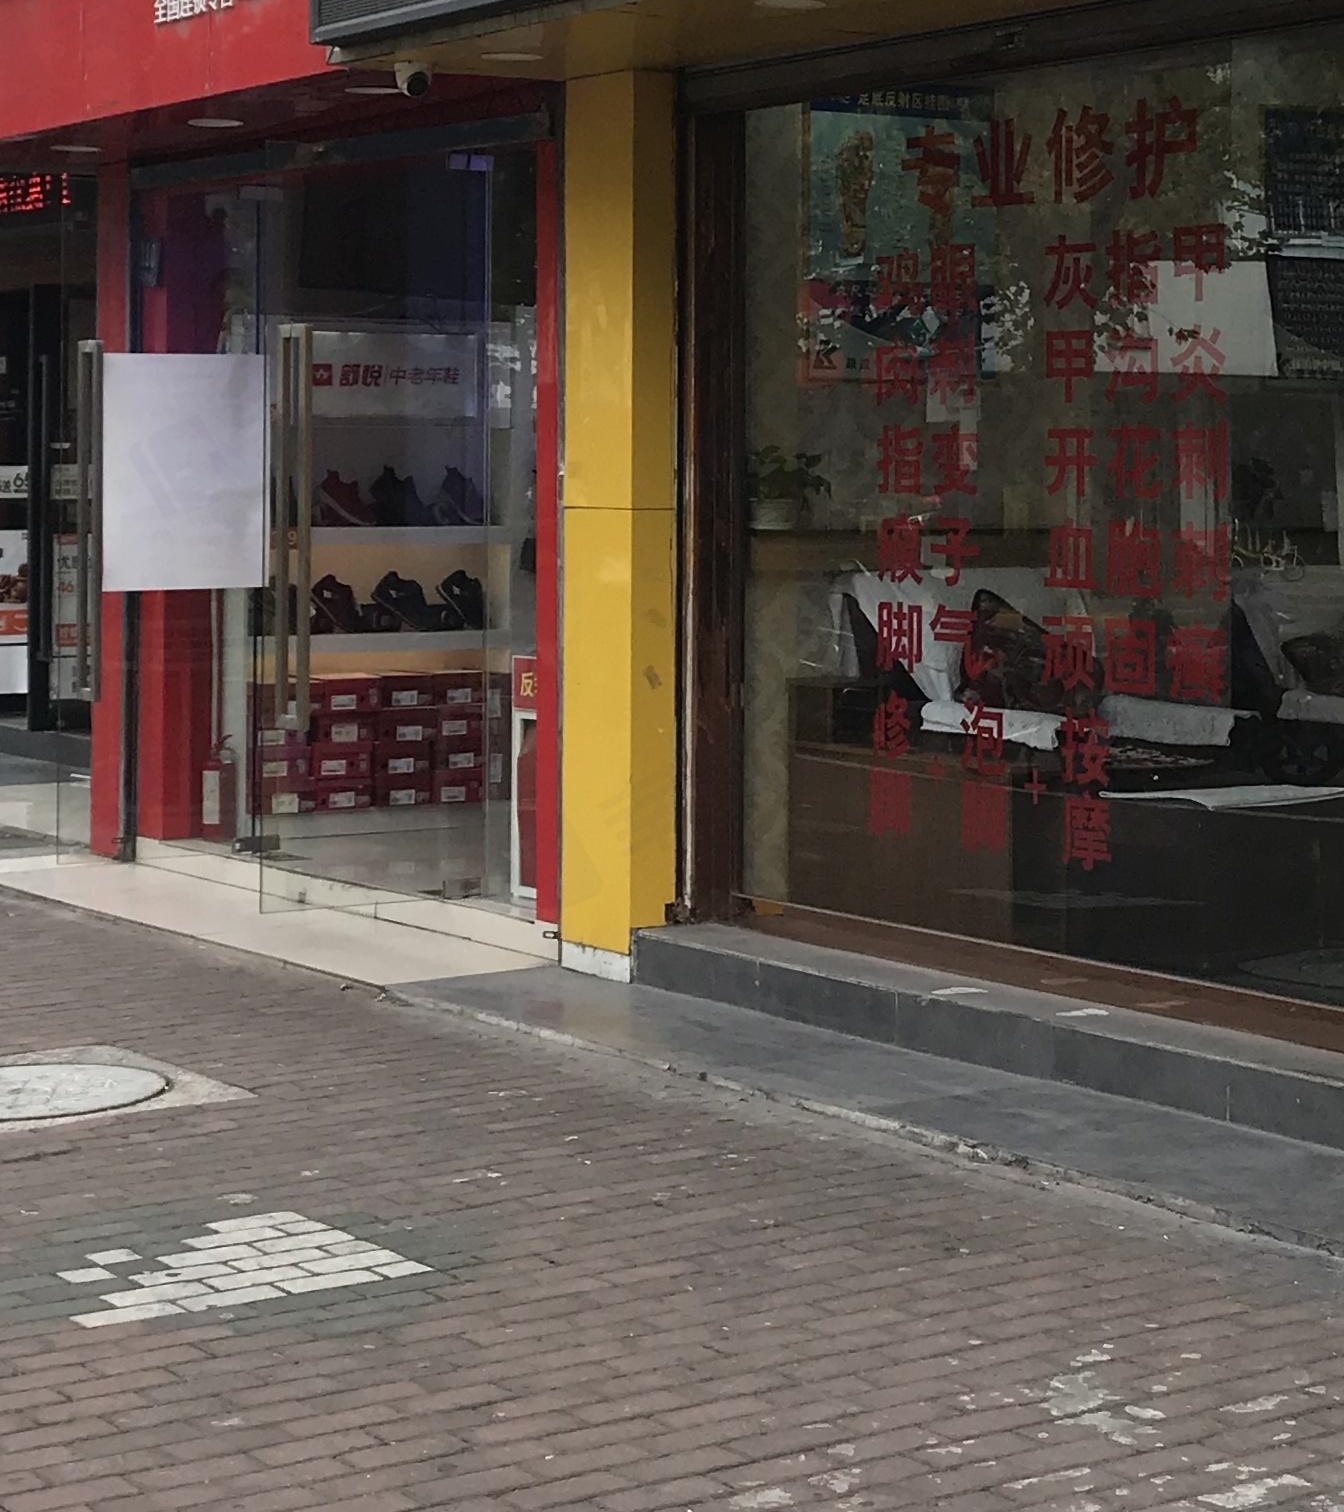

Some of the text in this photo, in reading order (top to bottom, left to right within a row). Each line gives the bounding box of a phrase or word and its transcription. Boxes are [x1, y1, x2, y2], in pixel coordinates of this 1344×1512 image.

[901, 95, 1198, 213] 专业修护
[876, 242, 978, 320] 鸡眼
[1043, 223, 1228, 311] 灰指甲
[340, 364, 460, 387] 舒悦 中老年鞋
[875, 335, 977, 407] 肉刺
[1044, 324, 1227, 403] 甲沟炎
[876, 425, 978, 496] 指变
[1044, 421, 1229, 501] 开花刺
[877, 600, 997, 681] 脚气
[1041, 615, 1229, 703] 顽固癣
[1060, 707, 1114, 871] 按摩
